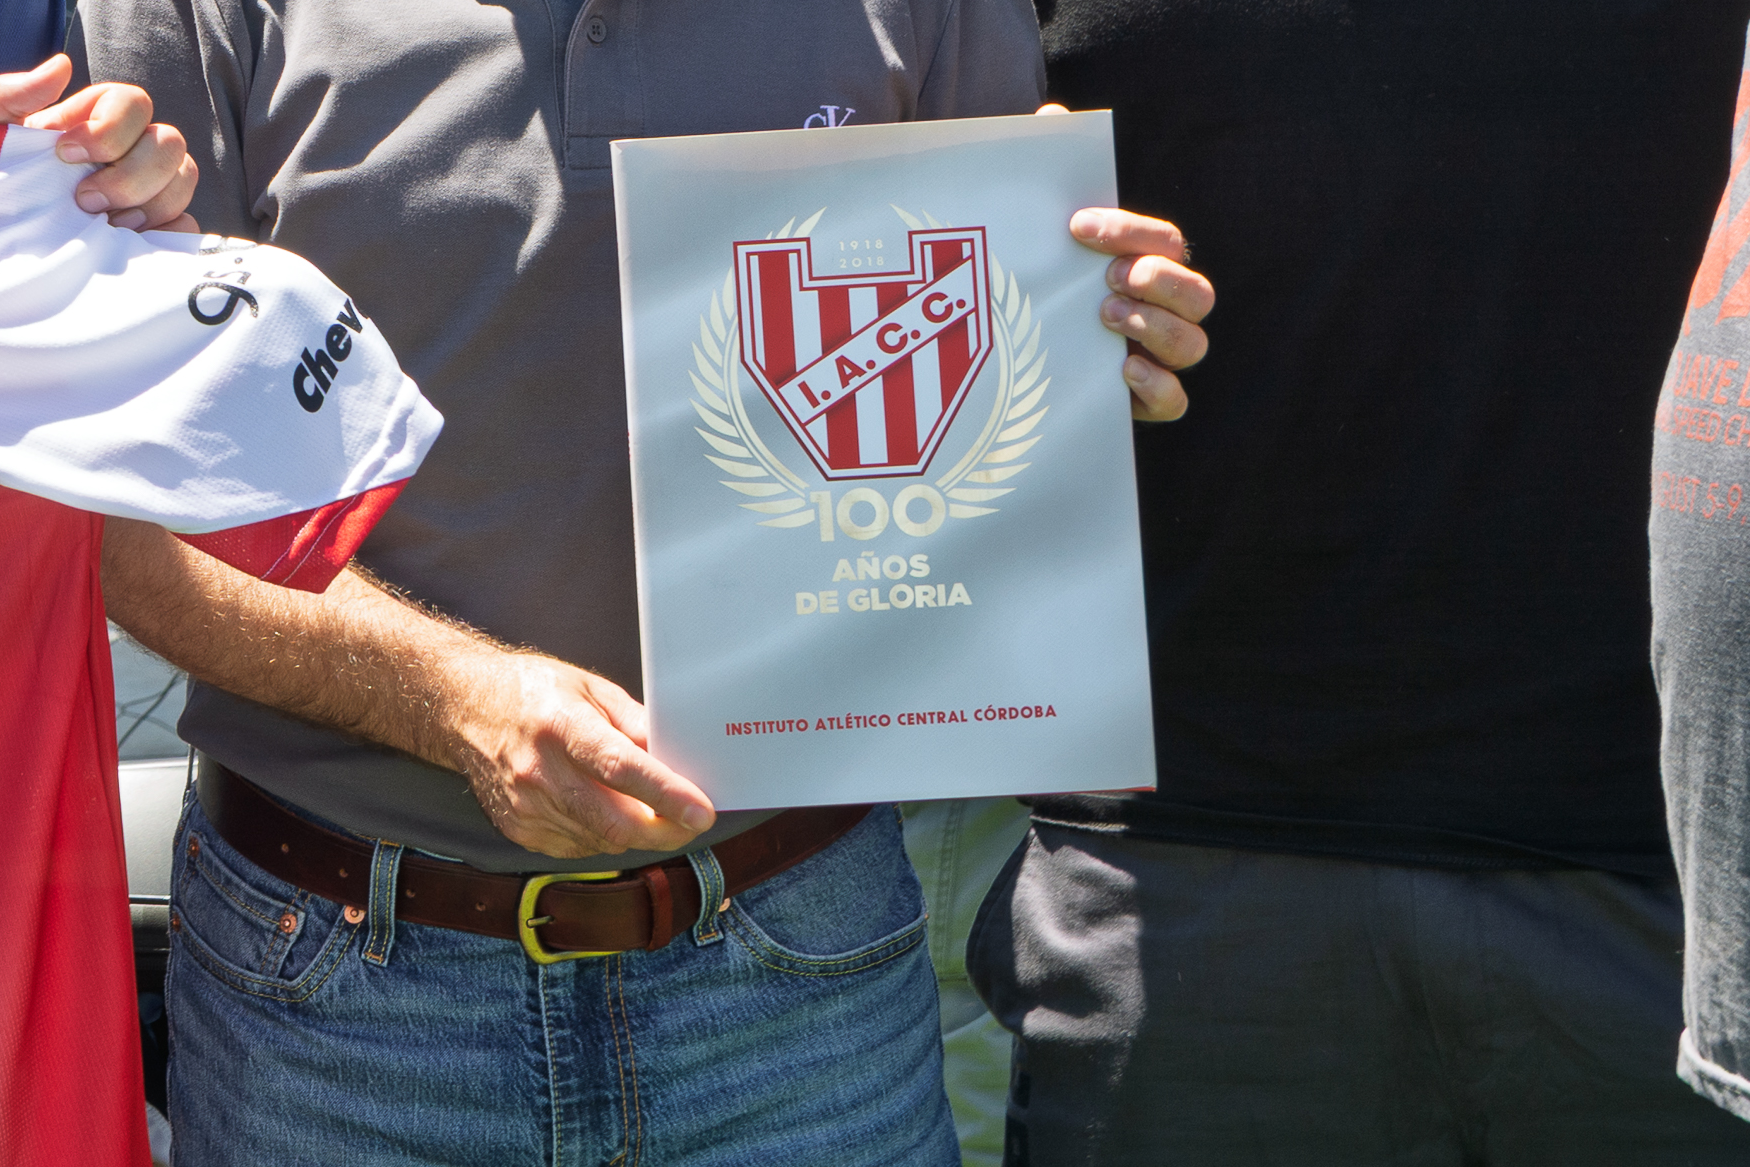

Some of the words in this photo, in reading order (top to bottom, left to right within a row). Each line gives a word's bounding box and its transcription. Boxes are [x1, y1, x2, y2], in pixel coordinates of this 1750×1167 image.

[839, 238, 884, 251] 1918
[839, 256, 885, 269] 2018
[1665, 350, 1740, 405] UAVE
[1671, 404, 1722, 443] SPEED
[809, 483, 947, 543] 100
[831, 550, 931, 582] AÑOS
[795, 591, 840, 615] DE
[847, 582, 973, 612] GLORIA
[725, 718, 809, 736] INSTITUTO
[814, 712, 891, 731] ATLÉTICO
[897, 709, 968, 727] CENTRAL
[973, 704, 1057, 722] CÓRDOBA
